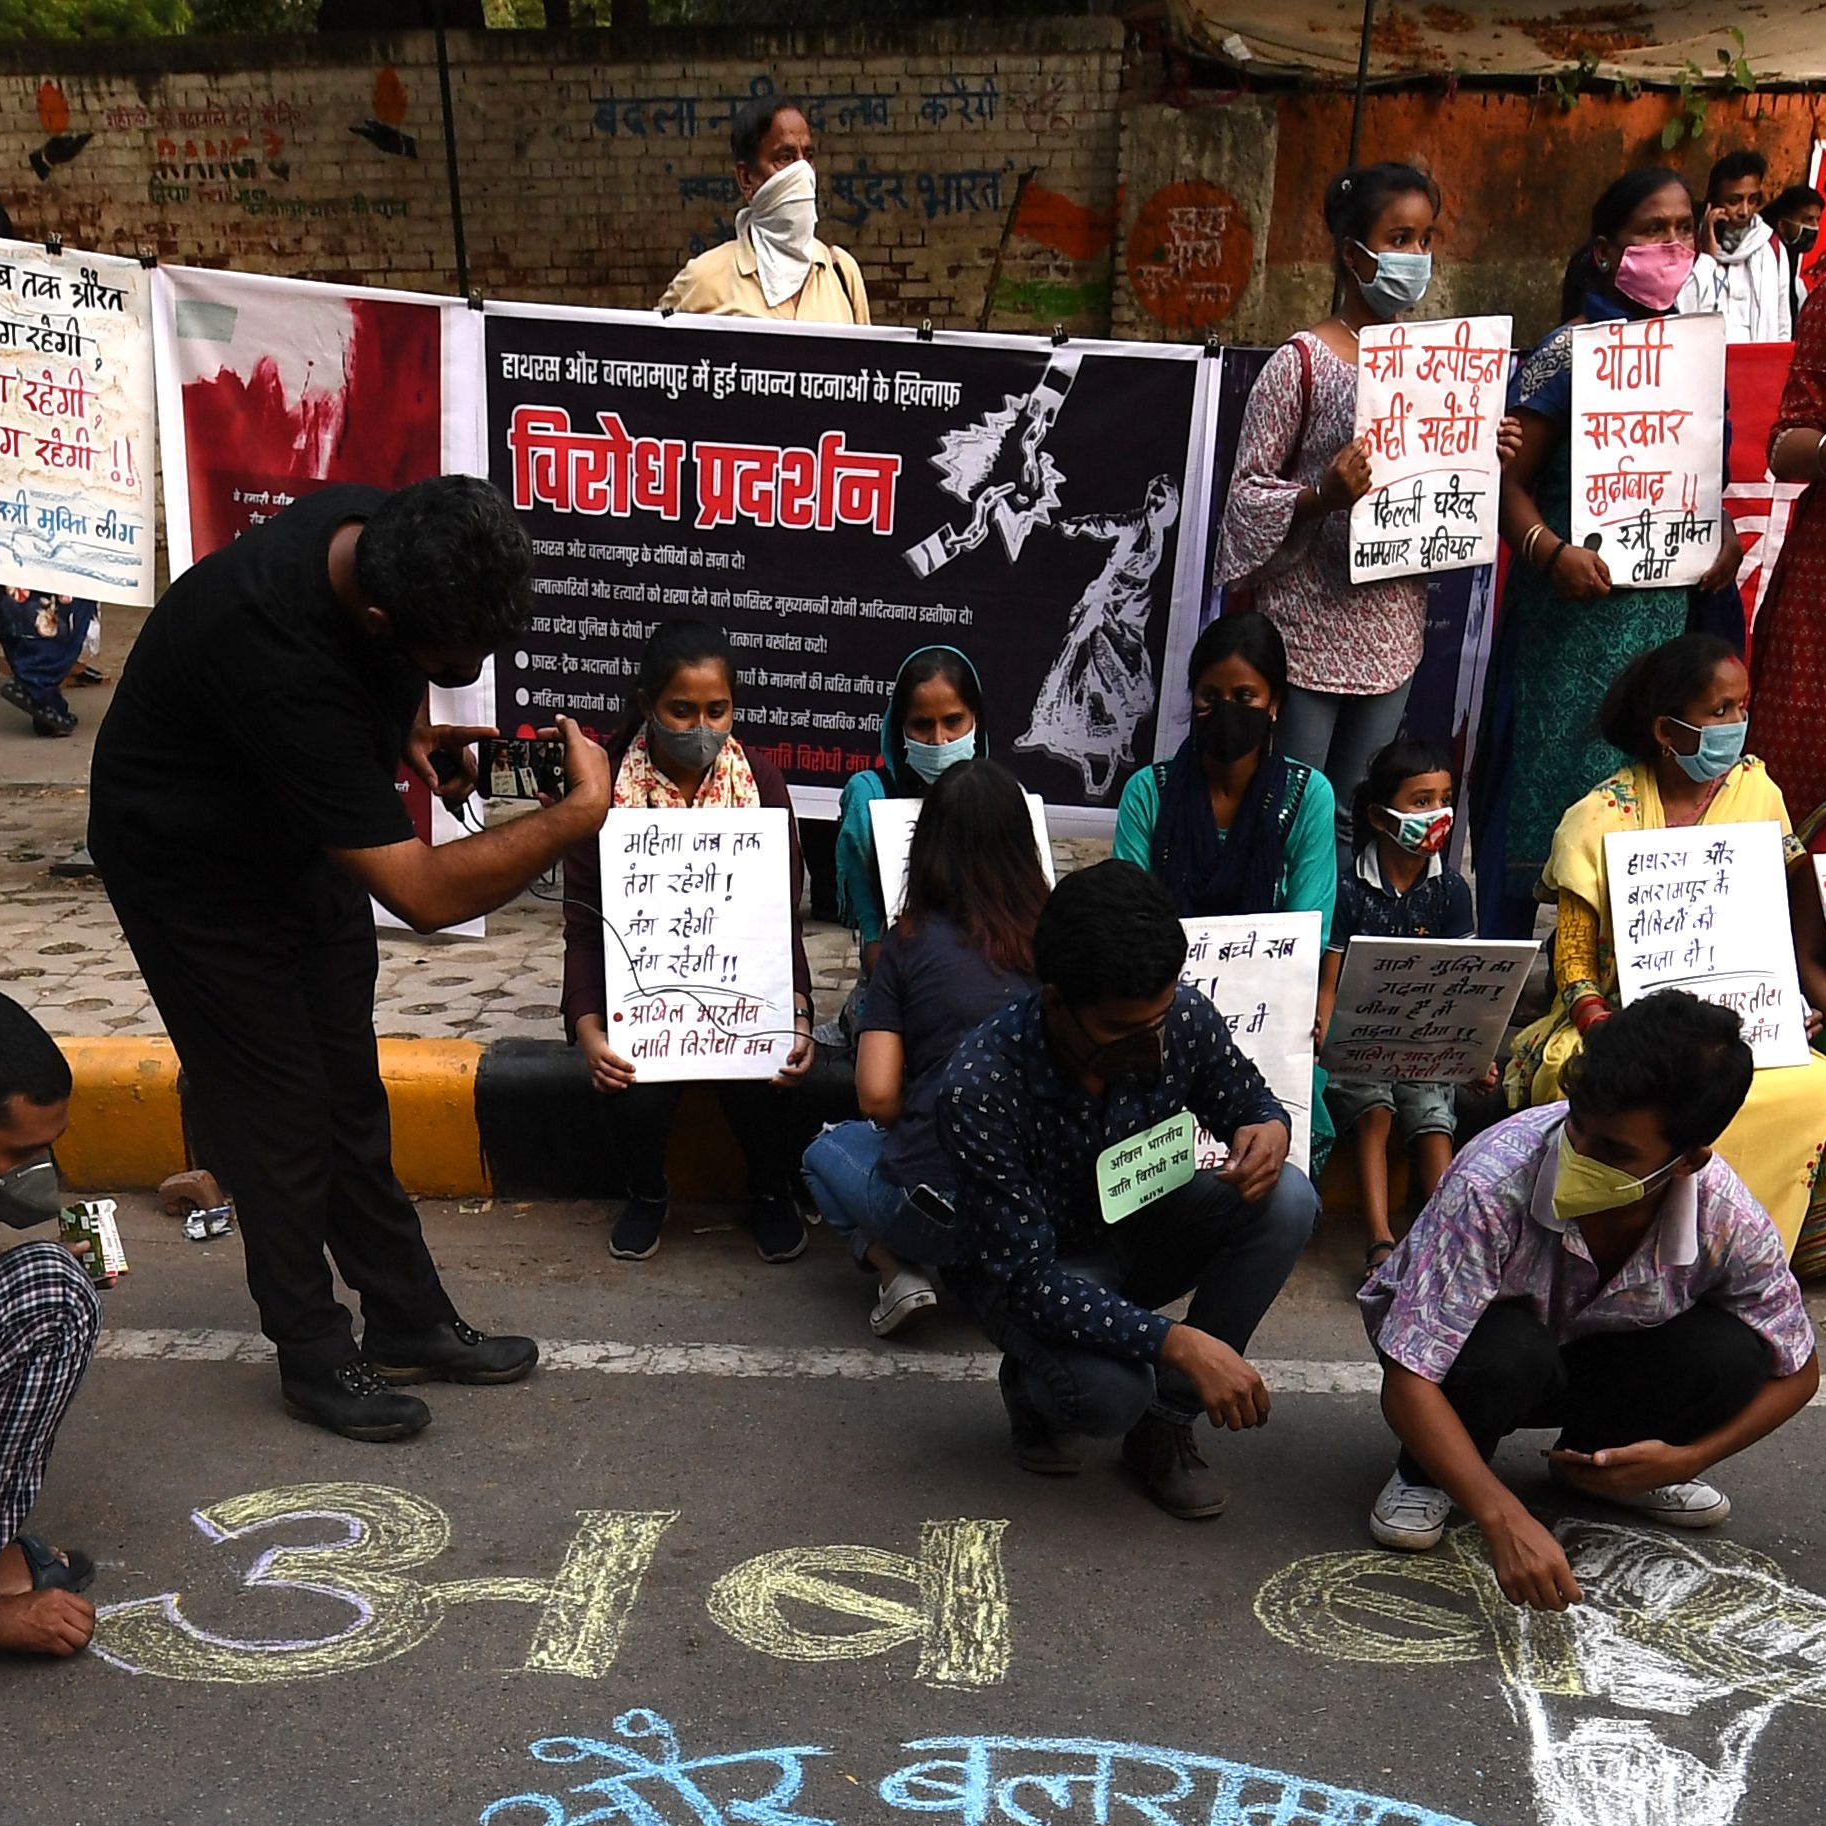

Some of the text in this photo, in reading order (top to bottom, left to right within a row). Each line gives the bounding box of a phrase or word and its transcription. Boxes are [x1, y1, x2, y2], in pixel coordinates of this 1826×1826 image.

[23, 270, 63, 301] तक
[72, 267, 127, 312] औरत
[1361, 325, 1412, 380] स्त्री
[1593, 319, 1673, 391] योगी
[501, 351, 890, 405] हाथरस और बलरामपुर में हुई जघन्य घटनाओं के
[1581, 410, 1693, 451] सरकार
[507, 404, 902, 535] विरोध प्रदर्शन
[1369, 479, 1427, 529] दिल्ली
[37, 504, 91, 543] मुक्ति
[96, 510, 143, 545] लीग
[1616, 505, 1717, 556] स्त्री मुक्ति
[588, 543, 639, 568] बलरामपुर
[1355, 525, 1481, 570] कामगार यूनियन
[1632, 547, 1676, 582] लीग
[663, 586, 916, 621] शरण देने वाले योगी आदित्यनाथ
[553, 614, 608, 640] प्रदेश पुलिस
[770, 671, 806, 690] मामलों
[532, 687, 767, 725] महिला करो
[624, 824, 682, 856] महिला
[623, 862, 660, 898] तंग
[1627, 851, 1692, 875] हाथरस
[1628, 879, 1710, 905] बलरामपुर
[624, 909, 659, 937] जंग
[1218, 930, 1299, 963] बच्चे सब
[1374, 955, 1521, 973] मार्ग का
[632, 1029, 671, 1058] जाति
[1109, 1145, 1143, 1171] अखिल
[1149, 1125, 1183, 1150] भारतीय
[1108, 1174, 1132, 1198] जाति
[1136, 1158, 1167, 1185] विरोधी
[1171, 1148, 1189, 1166] मंच
